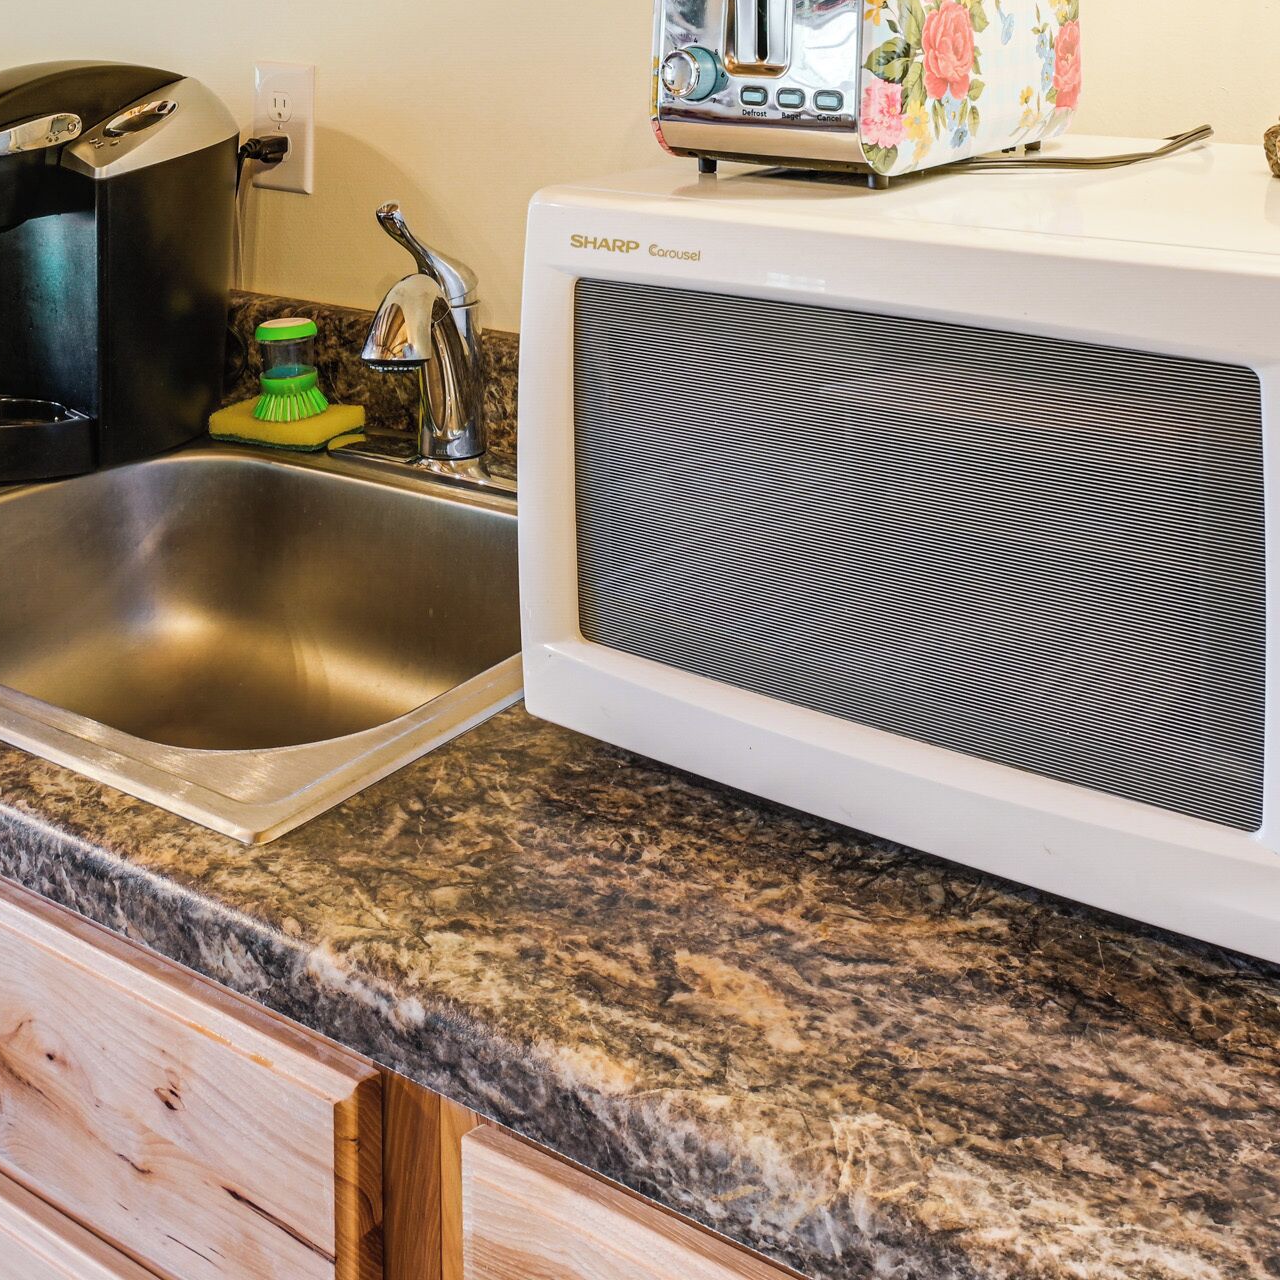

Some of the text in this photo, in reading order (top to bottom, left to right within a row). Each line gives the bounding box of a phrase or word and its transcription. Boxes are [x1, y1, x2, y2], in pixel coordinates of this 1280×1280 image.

[742, 109, 768, 118] Defrost
[781, 111, 802, 121] Bagel
[816, 114, 842, 122] Cancel
[570, 234, 701, 261] SHARP Carousel
